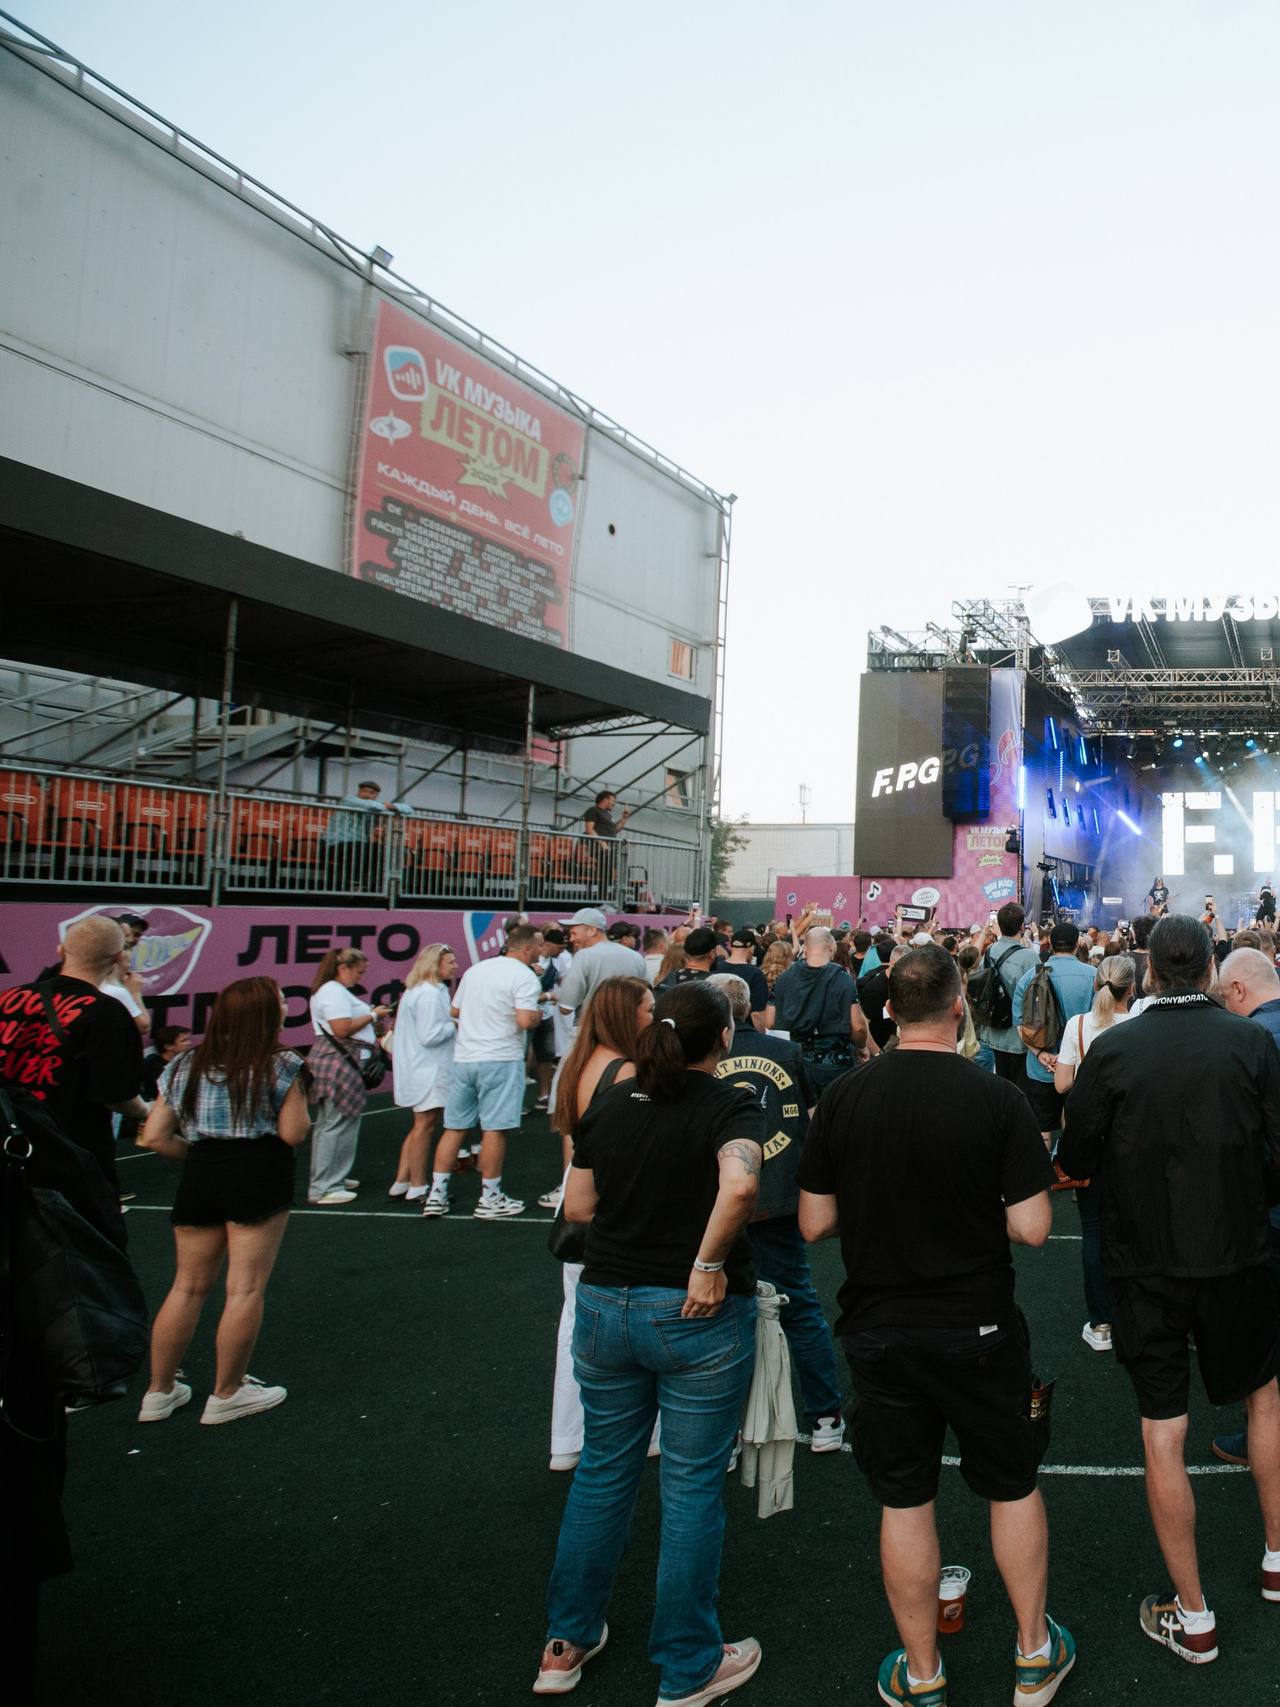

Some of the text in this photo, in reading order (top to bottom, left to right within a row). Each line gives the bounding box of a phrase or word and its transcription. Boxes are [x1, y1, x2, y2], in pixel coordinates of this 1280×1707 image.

[436, 359, 542, 442] VK МУЗЫКА
[430, 393, 541, 484] ЛЕТОМ
[377, 462, 456, 505] КАЖДЫЙ
[504, 519, 530, 539] ВСЁ
[532, 533, 564, 556] ЛЕТО
[1108, 592, 1158, 623] VK
[981, 826, 1008, 834] МУЗЫК
[237, 923, 420, 966] ЛЕТО
[733, 1058, 785, 1082] MINIONS
